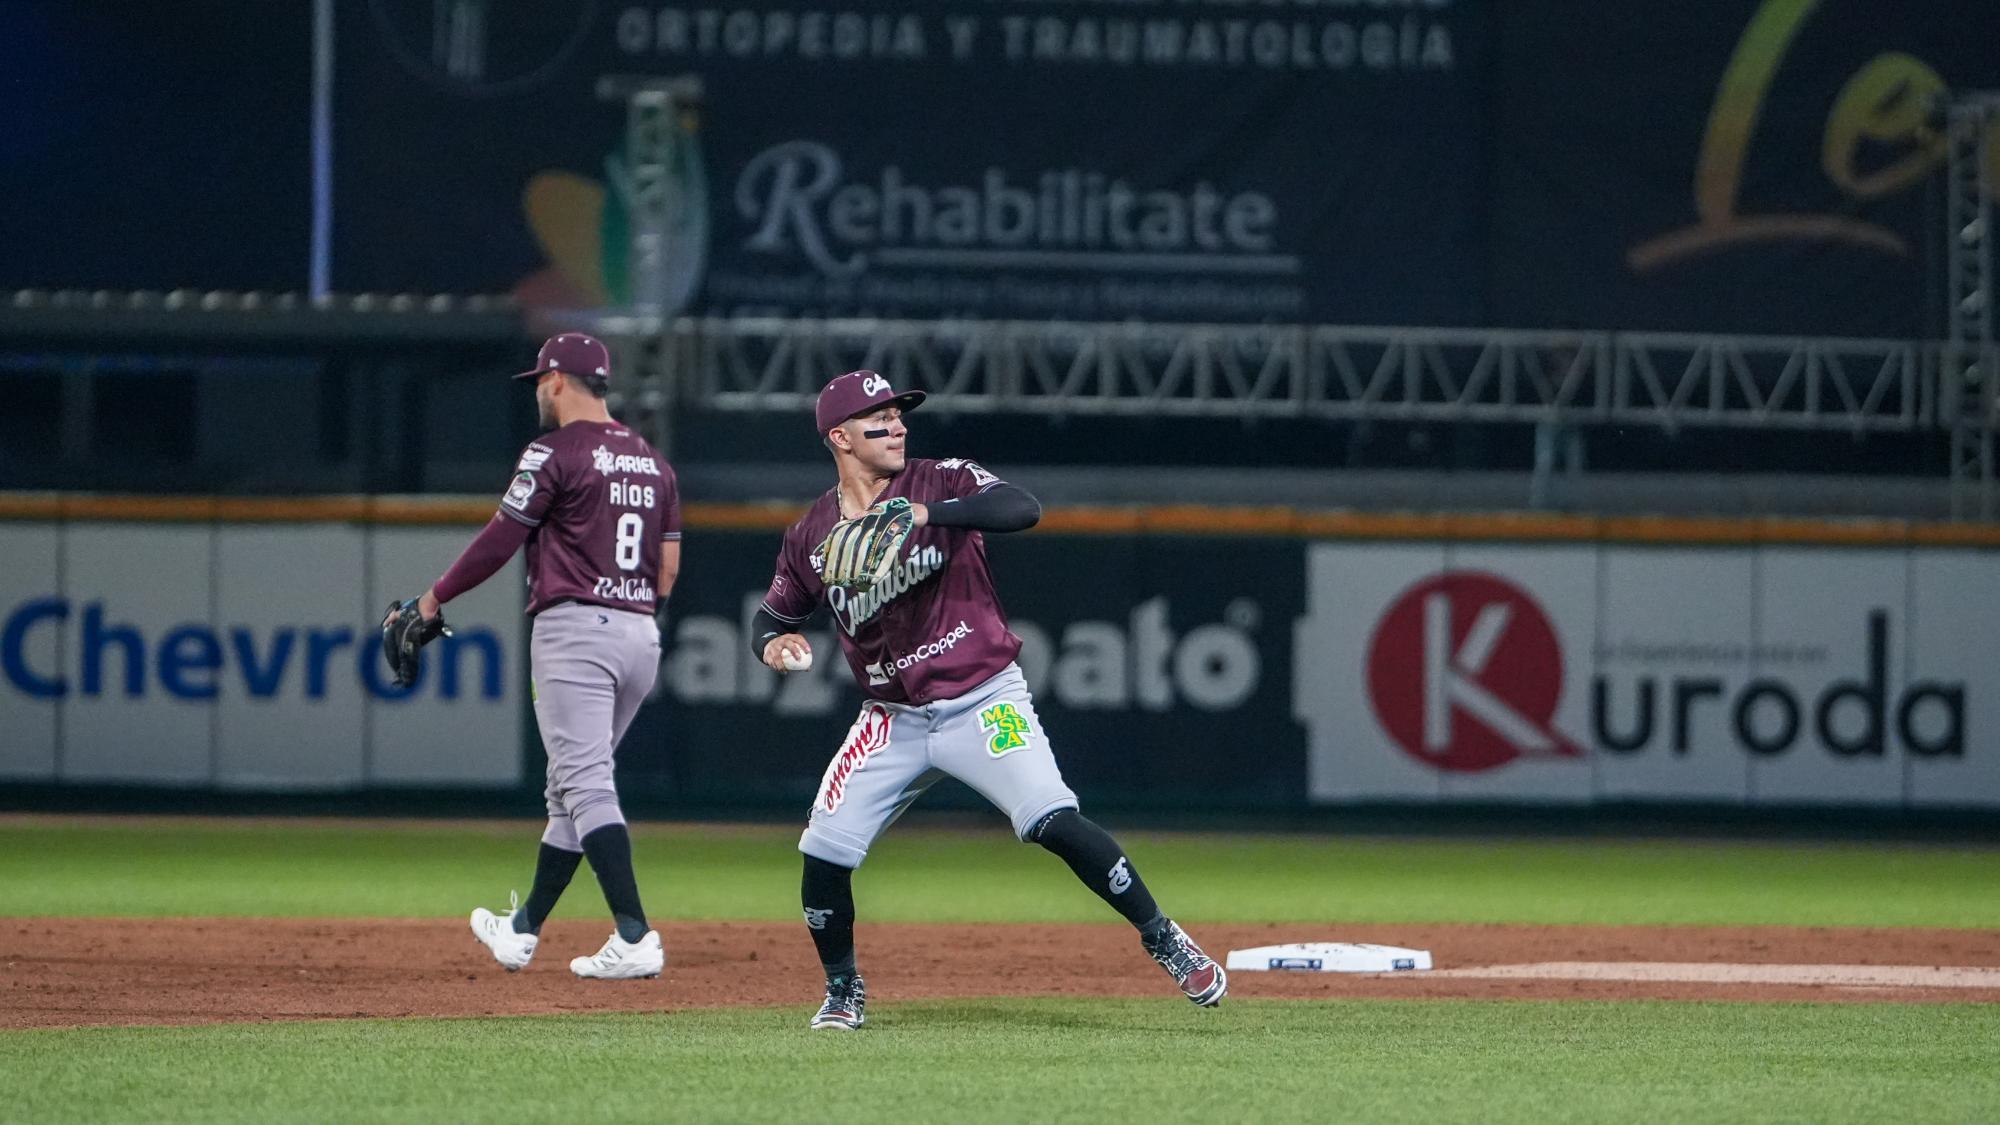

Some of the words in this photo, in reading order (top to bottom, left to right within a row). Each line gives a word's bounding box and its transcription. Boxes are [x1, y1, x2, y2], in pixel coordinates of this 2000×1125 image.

[617, 8, 928, 60] ORTOPEDIA
[945, 14, 981, 61] Y
[1003, 13, 1455, 70] TRAUMATOLOGÍA
[734, 139, 1279, 277] Rehabilitate
[610, 477, 656, 509] RÍOS
[615, 454, 661, 476] ARIEL
[615, 512, 643, 570] 8
[0, 595, 504, 703] Chevron
[885, 621, 974, 677] BanCoppel
[1424, 590, 1966, 758] Kuroda
[823, 704, 893, 811] Caliente
